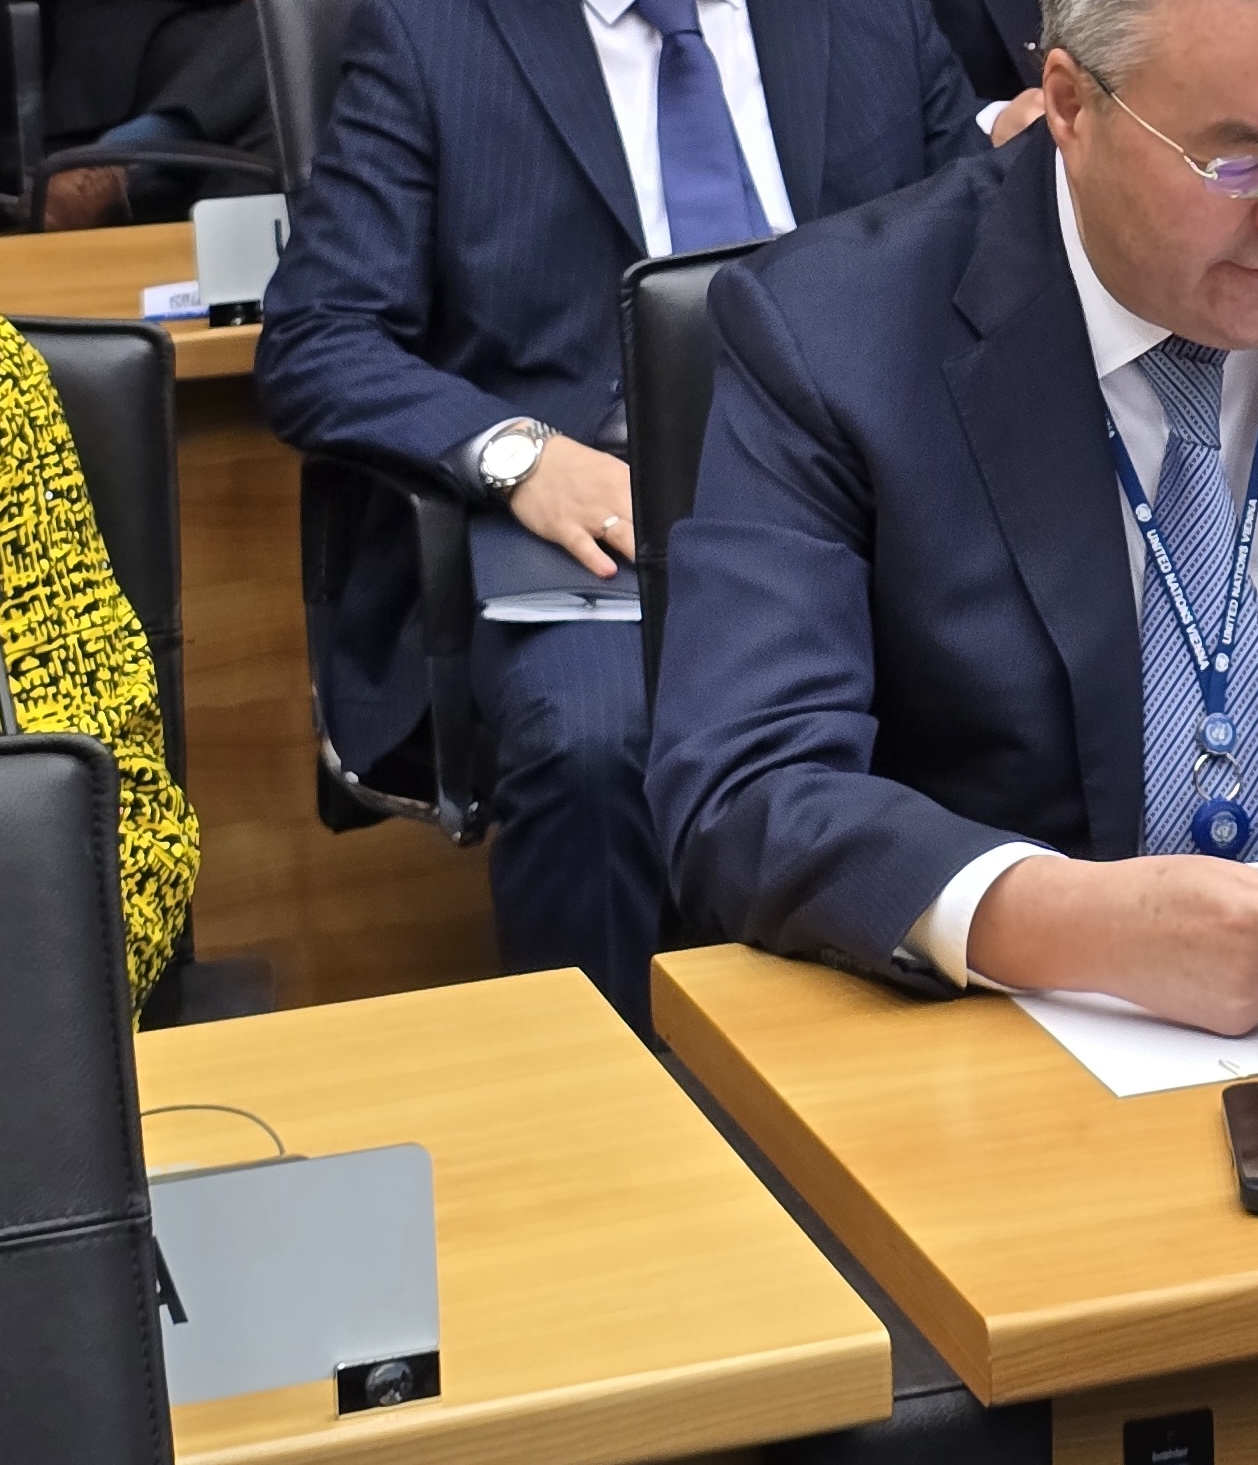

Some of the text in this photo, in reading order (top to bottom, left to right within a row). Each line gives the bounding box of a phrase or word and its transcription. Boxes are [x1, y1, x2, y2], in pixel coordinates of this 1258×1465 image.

[1146, 529, 1172, 573] UNITED
[1165, 573, 1194, 625] NATIONS
[1222, 599, 1239, 645] UNITED
[1231, 545, 1249, 598] NATIONS
